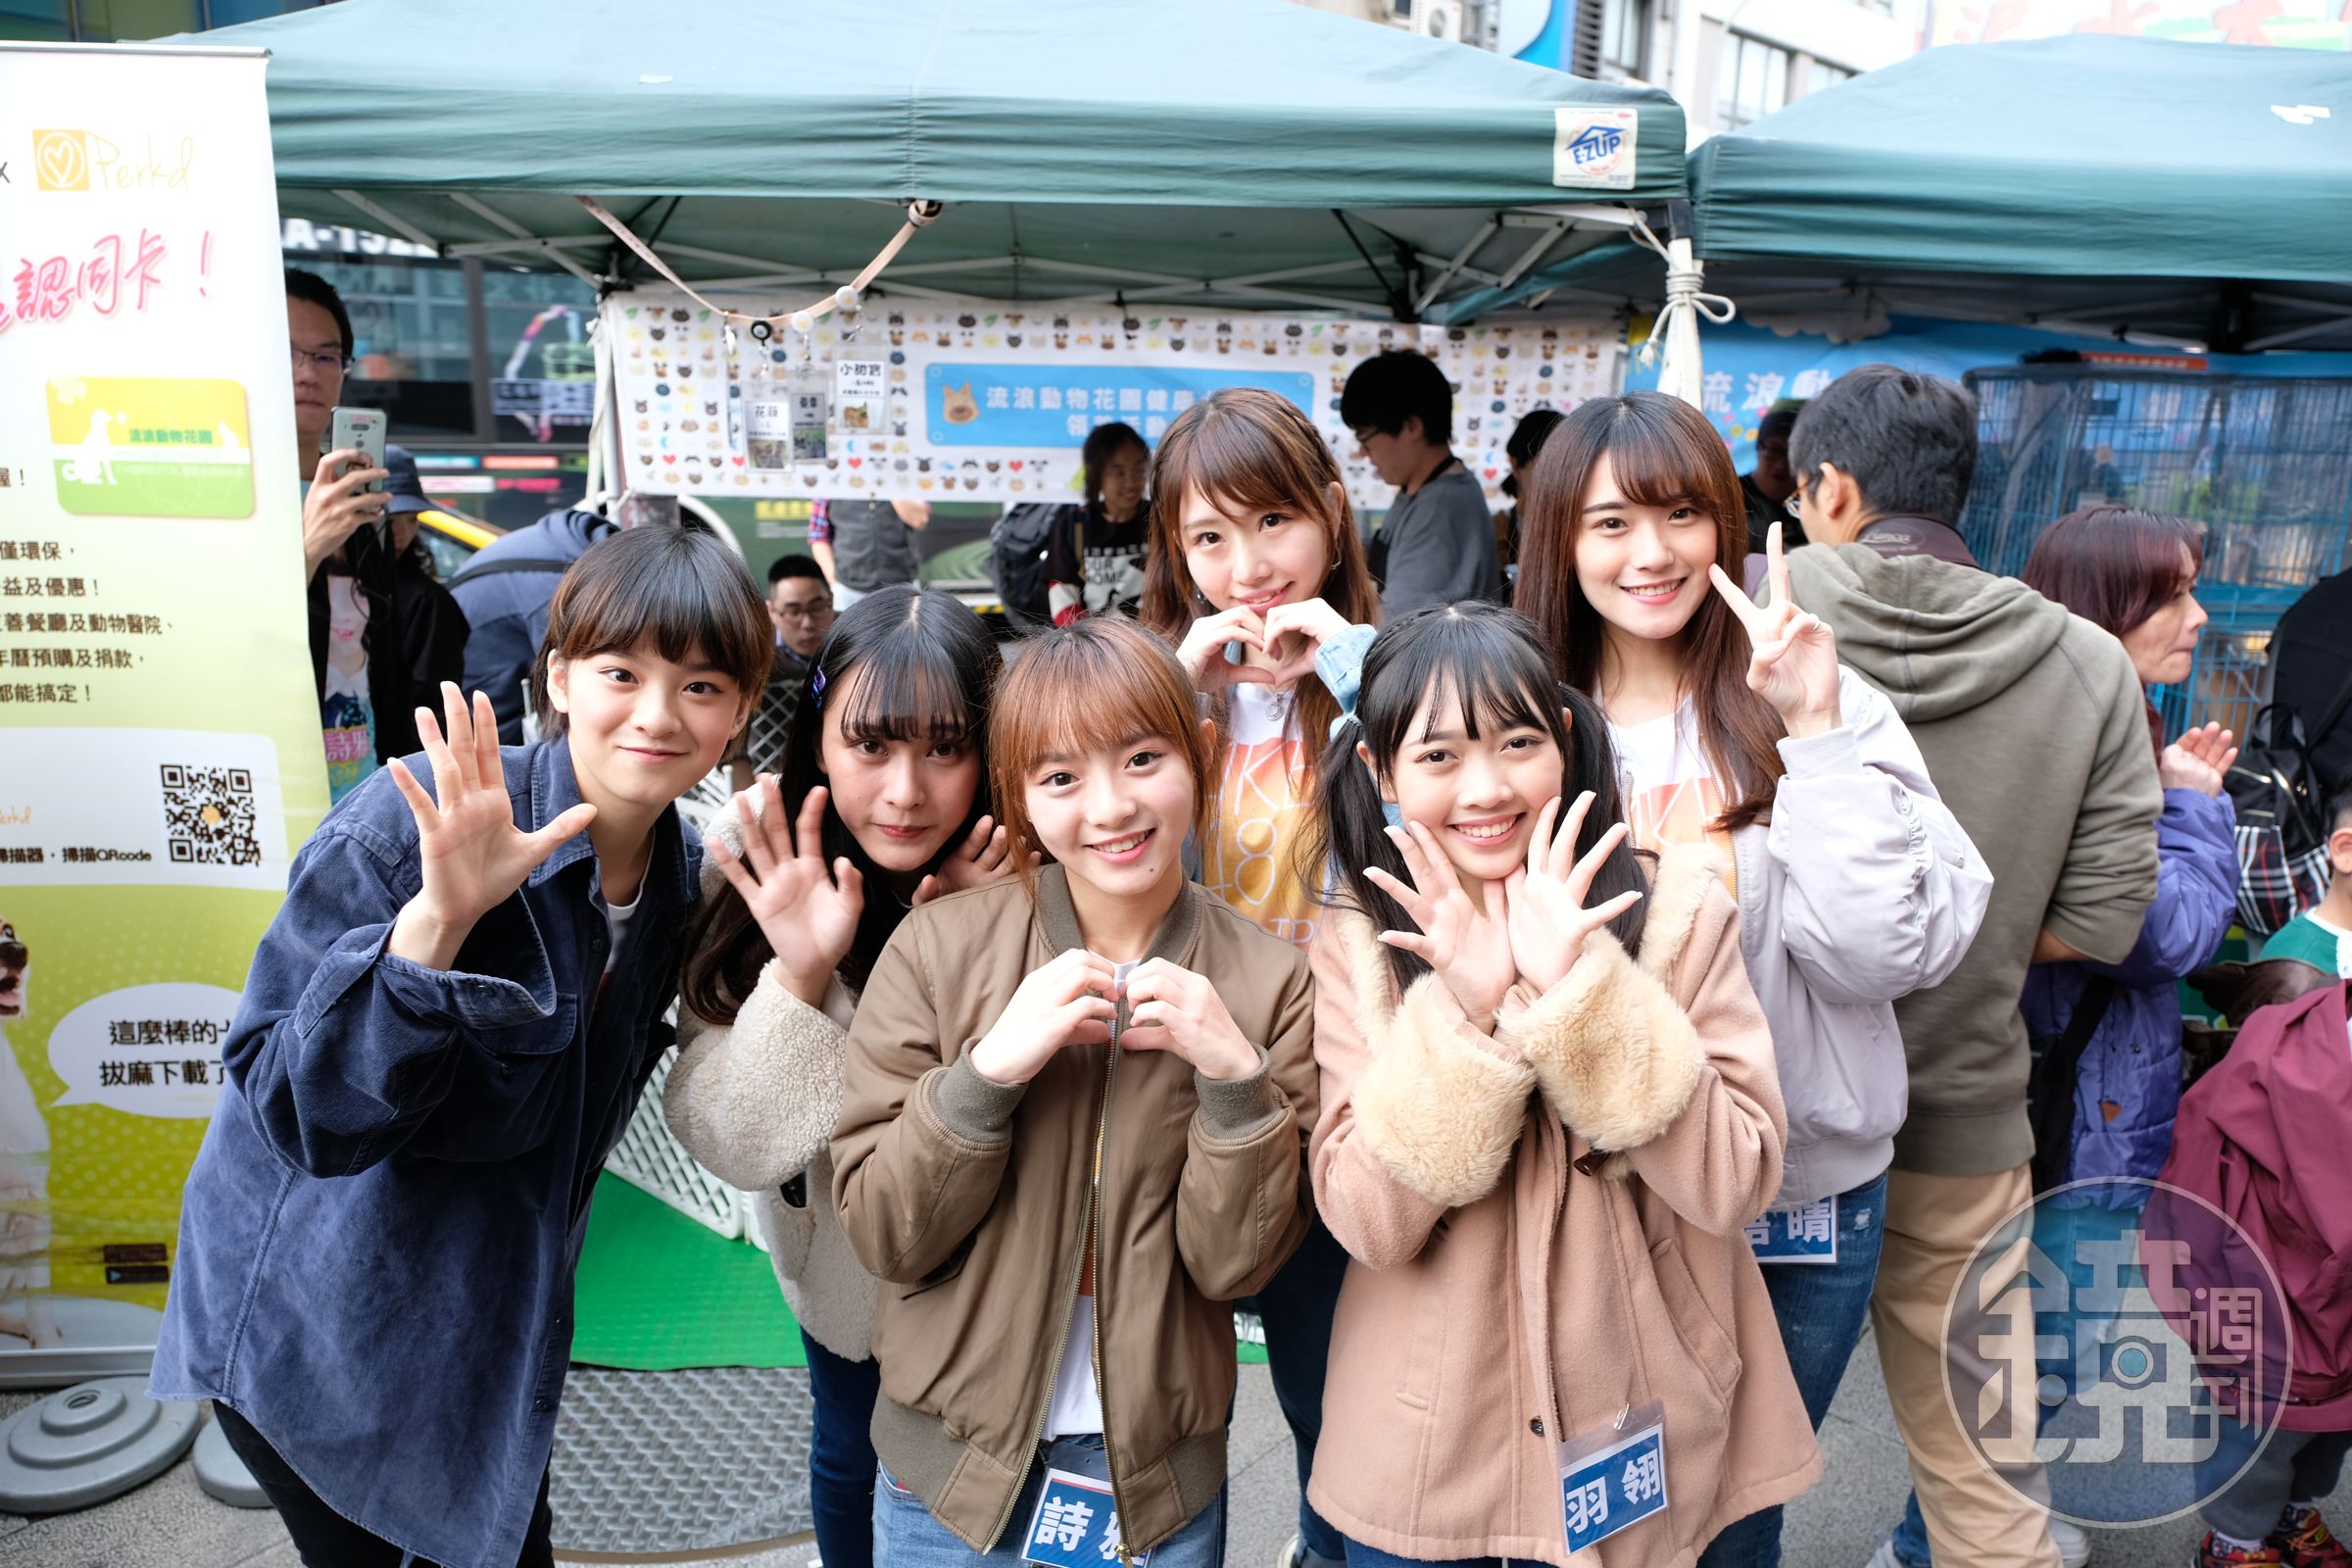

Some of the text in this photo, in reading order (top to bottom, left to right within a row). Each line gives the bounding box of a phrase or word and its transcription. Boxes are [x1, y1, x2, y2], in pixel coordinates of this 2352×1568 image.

[986, 386, 1217, 413] 流浪動物花園健康
[3, 576, 99, 597] 益及優惠！
[0, 612, 172, 635] 善餐廳及動物醫院、
[0, 806, 32, 825] erkd
[1566, 1447, 1661, 1535] 羽翎
